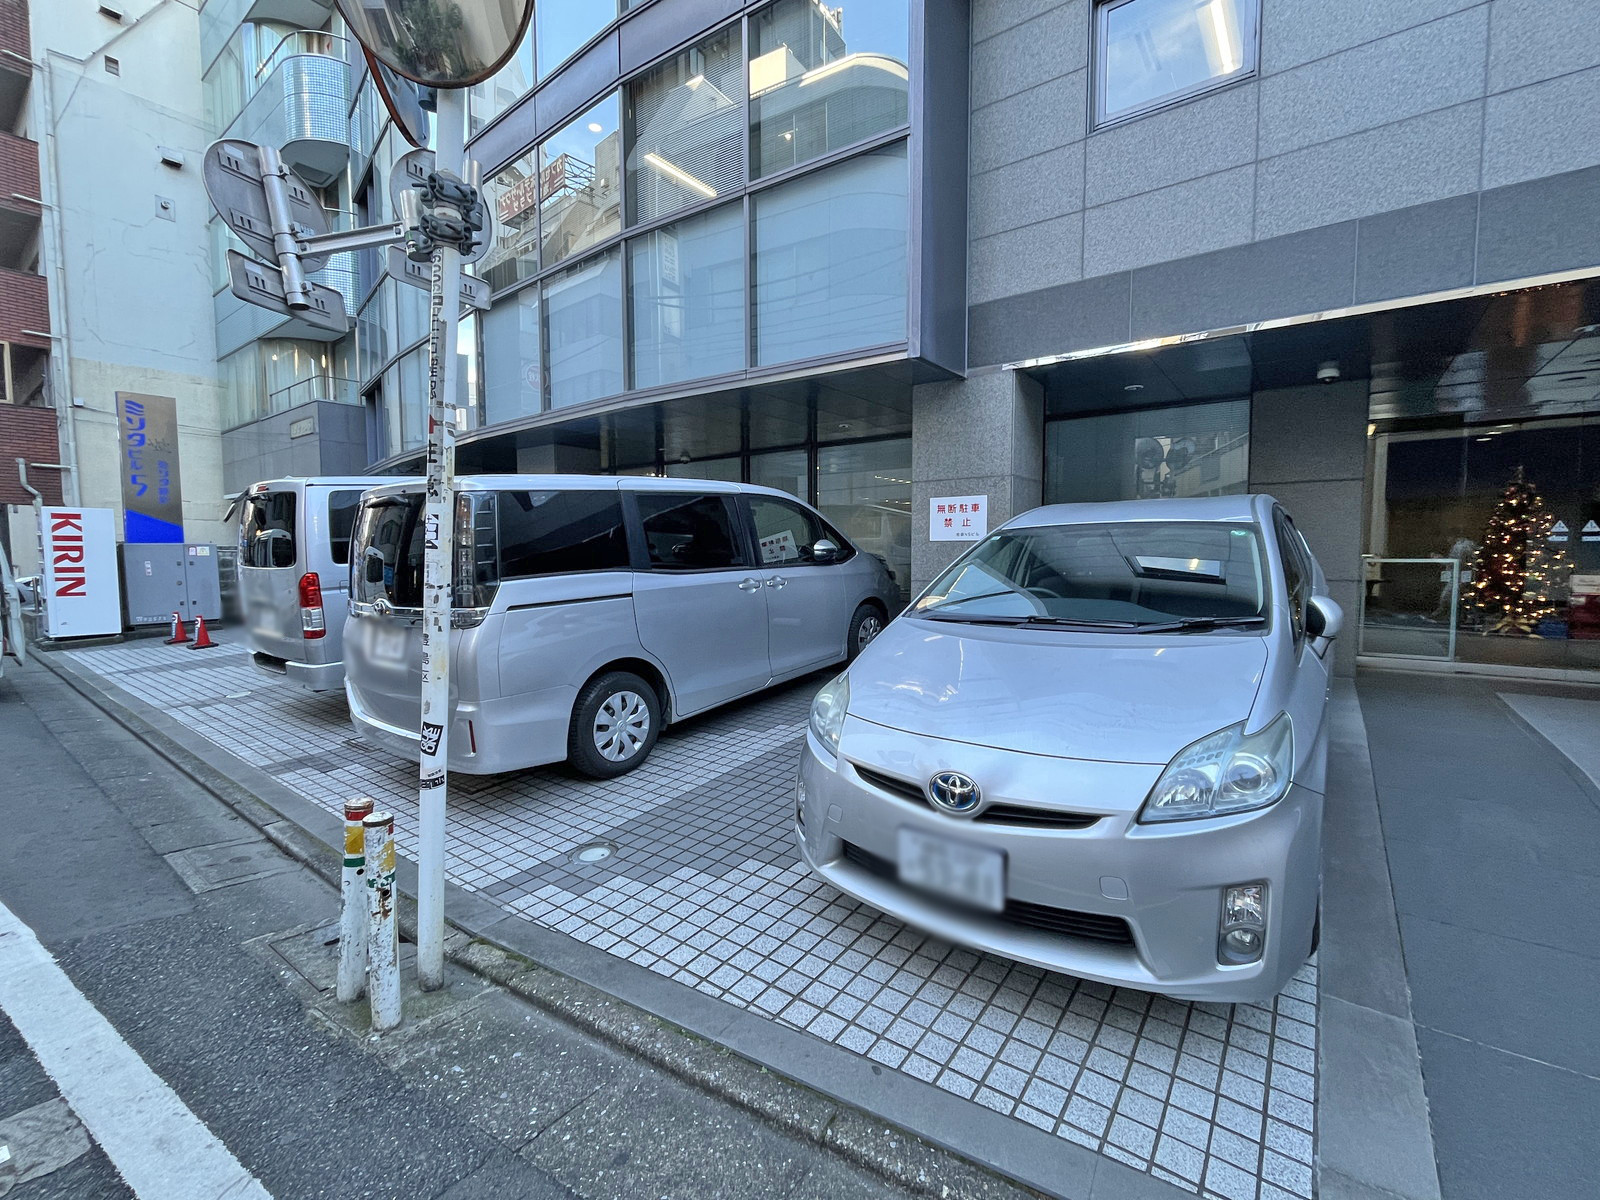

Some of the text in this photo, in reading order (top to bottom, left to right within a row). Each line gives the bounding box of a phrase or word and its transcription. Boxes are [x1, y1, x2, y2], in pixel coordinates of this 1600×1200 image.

[937, 503, 980, 514] 無断駐車
[944, 517, 971, 527] 禁止
[50, 512, 87, 597] KIRIN
